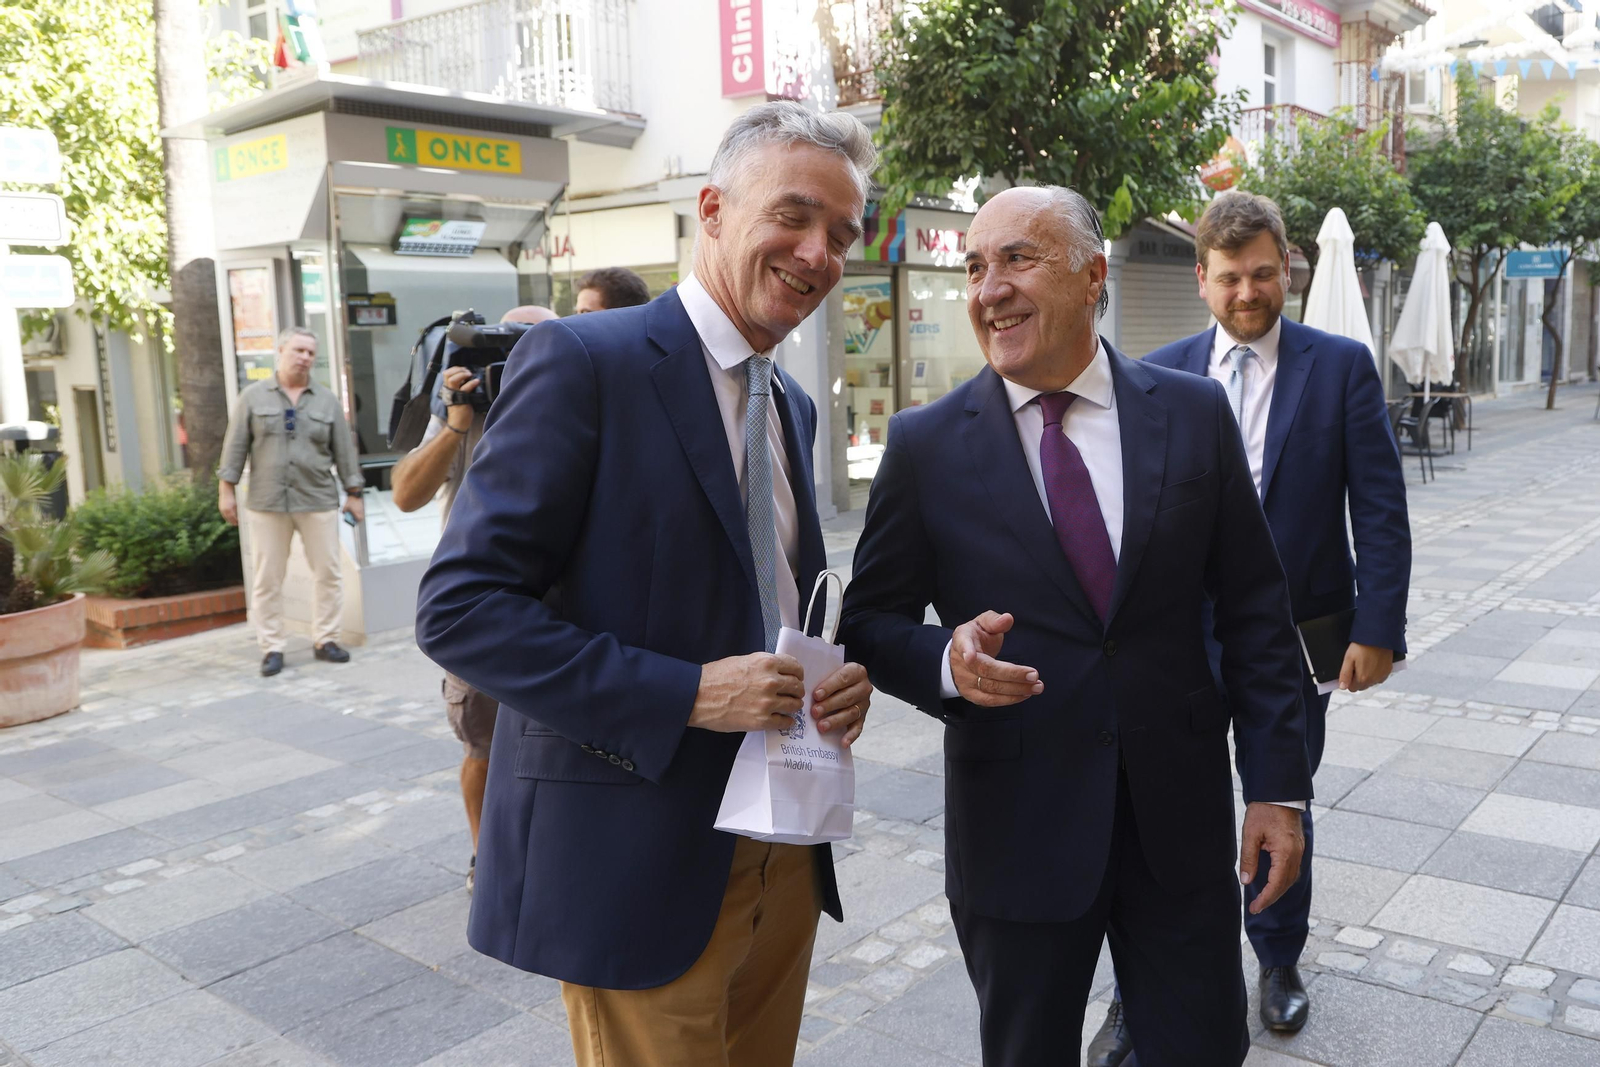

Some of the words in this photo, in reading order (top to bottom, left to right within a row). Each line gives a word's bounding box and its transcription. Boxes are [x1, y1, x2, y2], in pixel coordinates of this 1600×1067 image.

[236, 139, 280, 171] ONCE
[428, 137, 511, 168] ONCE
[780, 743, 806, 757] British
[806, 747, 839, 763] Embassy
[784, 758, 813, 771] Madrid
